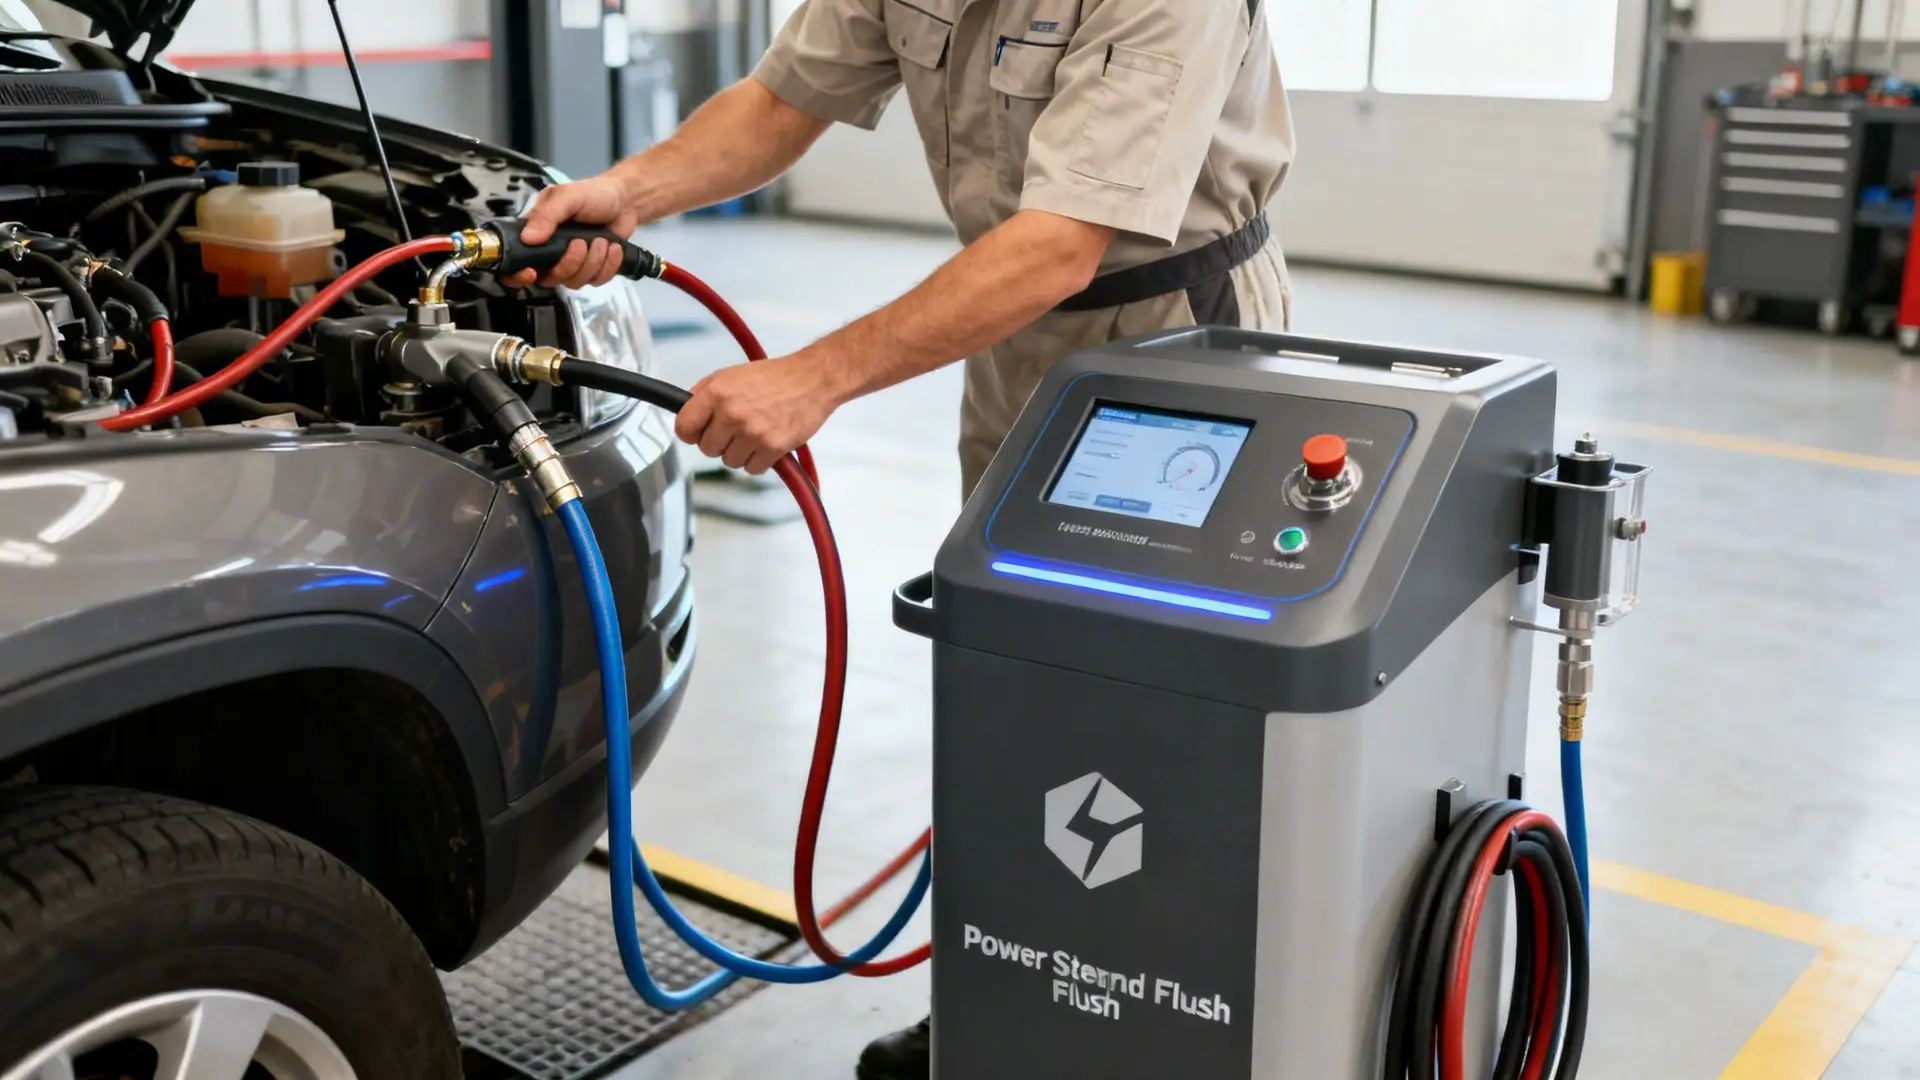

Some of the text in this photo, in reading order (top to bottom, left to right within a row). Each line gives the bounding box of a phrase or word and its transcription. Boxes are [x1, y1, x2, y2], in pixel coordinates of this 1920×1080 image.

[964, 924, 1048, 970] Power
[1155, 978, 1230, 1024] Flush
[1053, 979, 1120, 1020] Flush
